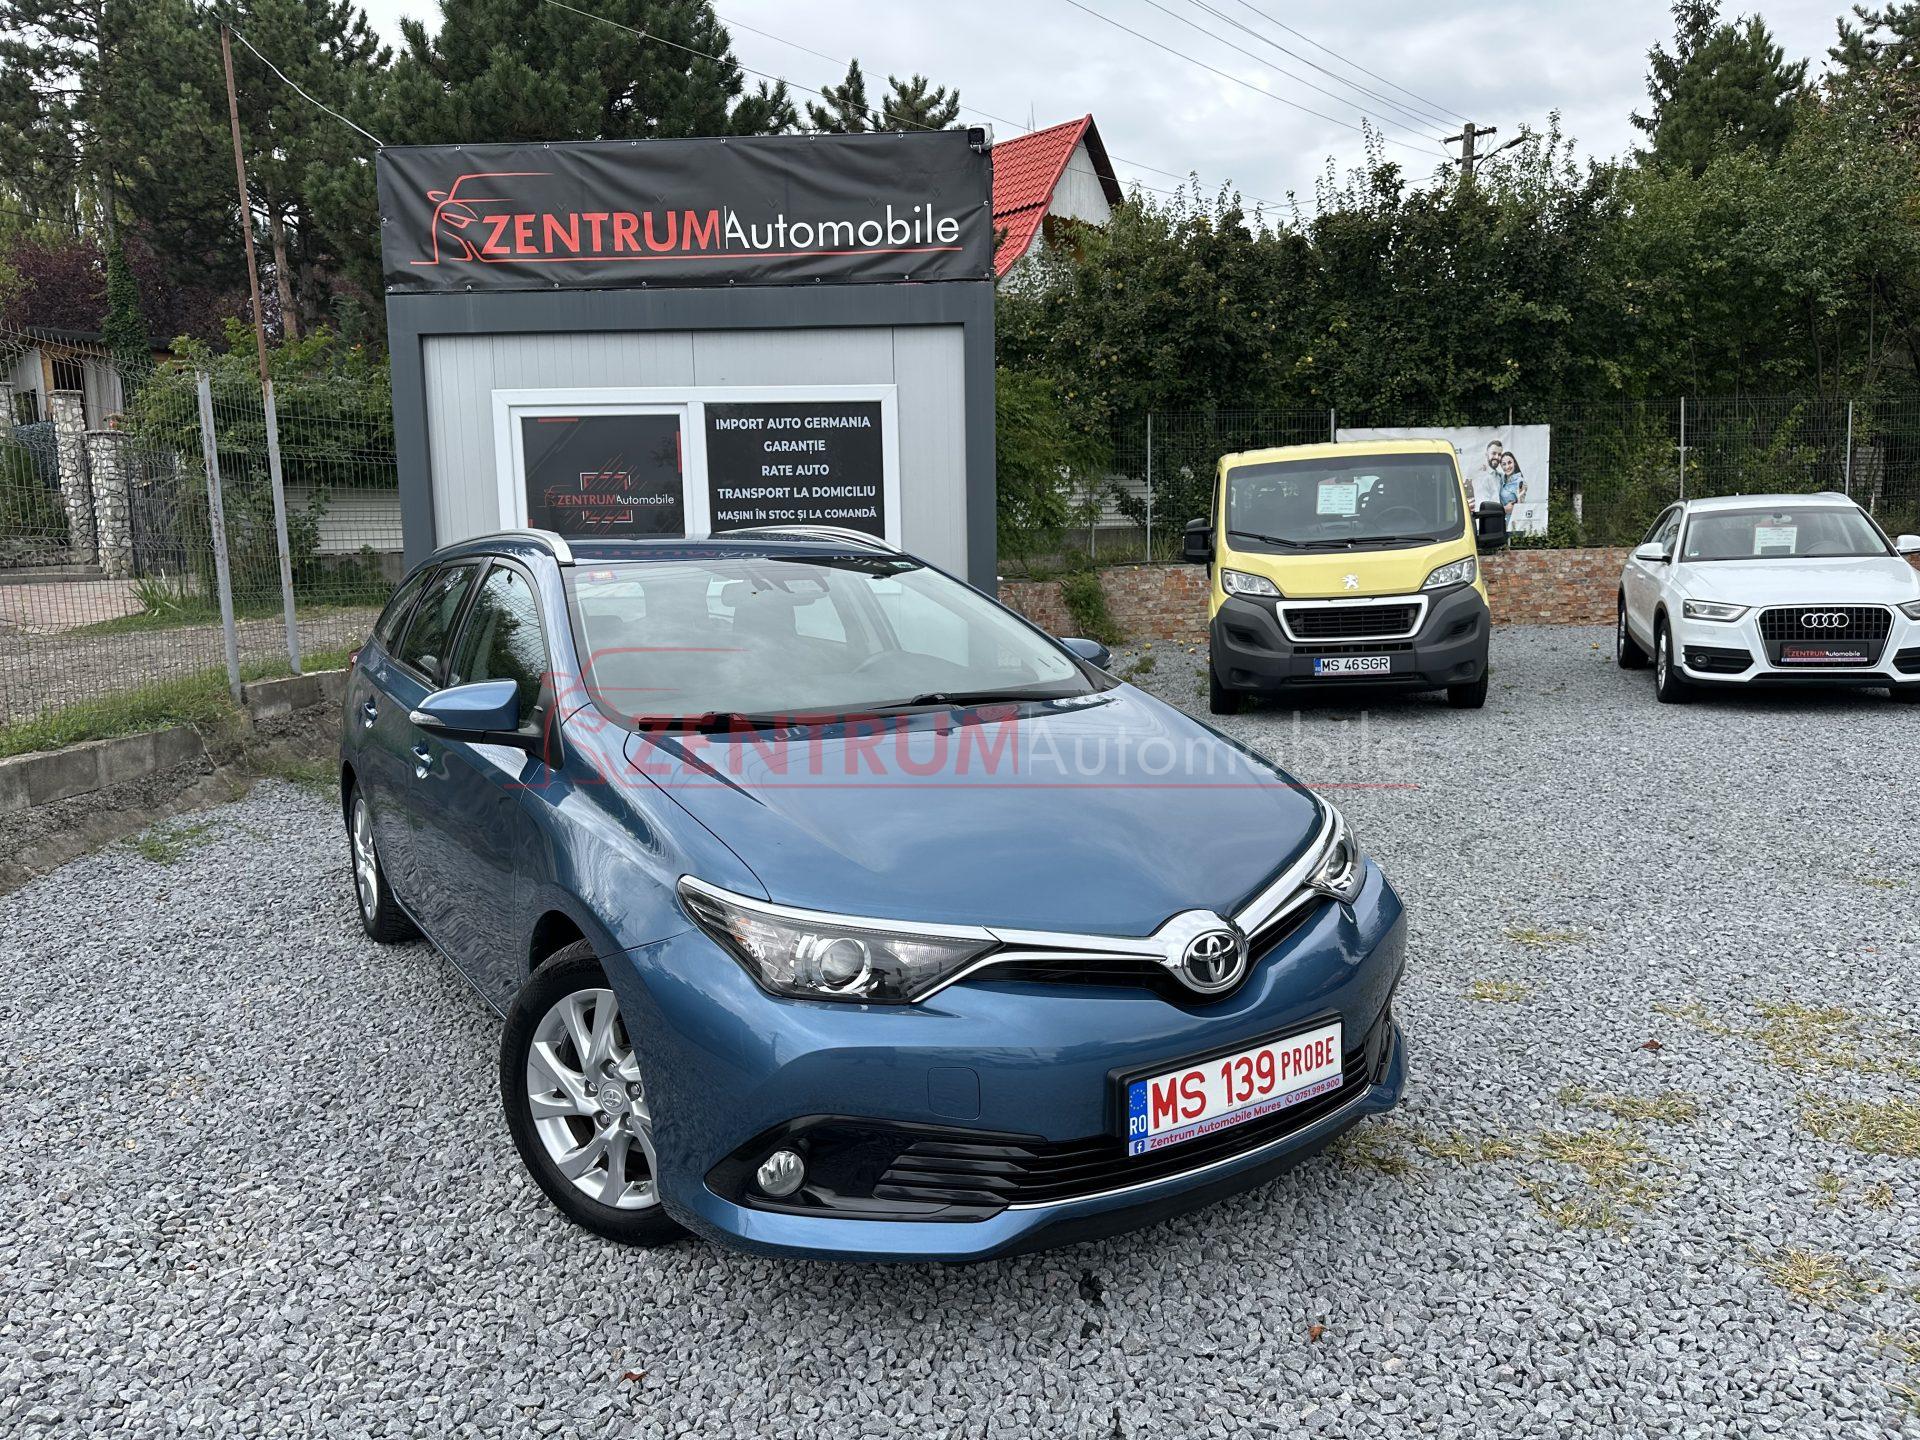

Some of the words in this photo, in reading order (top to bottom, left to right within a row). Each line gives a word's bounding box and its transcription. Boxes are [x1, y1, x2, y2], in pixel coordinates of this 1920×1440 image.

[481, 209, 721, 254] ZENTRUM
[726, 203, 960, 250] Automobile
[715, 418, 764, 430] IMPORT
[767, 418, 801, 429] AUTO
[804, 416, 871, 429] GERMANIA
[764, 440, 826, 454] GARANȚIE
[762, 465, 793, 476] RATE
[795, 464, 830, 475] AUTO
[717, 487, 791, 499] TRANSPORT
[793, 487, 809, 498] LA
[812, 486, 876, 497] DOMICILIU
[557, 494, 616, 506] ZENTRUM
[616, 494, 675, 505] Automobile
[717, 510, 753, 522] MAȘINI
[756, 508, 766, 520] ÎN
[769, 510, 795, 520] STOC
[797, 510, 807, 522] ȘI
[809, 509, 822, 519] LA
[824, 506, 877, 518] COMANDĂ
[1322, 659, 1340, 671] MS
[1151, 1070, 1207, 1129] MS
[1221, 1049, 1276, 1107] 139
[1281, 1035, 1335, 1080] PROBE
[1150, 1128, 1195, 1149] Zentrum
[1197, 1110, 1252, 1135] Automobile
[1253, 1101, 1281, 1117] Mures
[1294, 1078, 1340, 1102] 0751.999.900
[1130, 1114, 1147, 1136] RO
